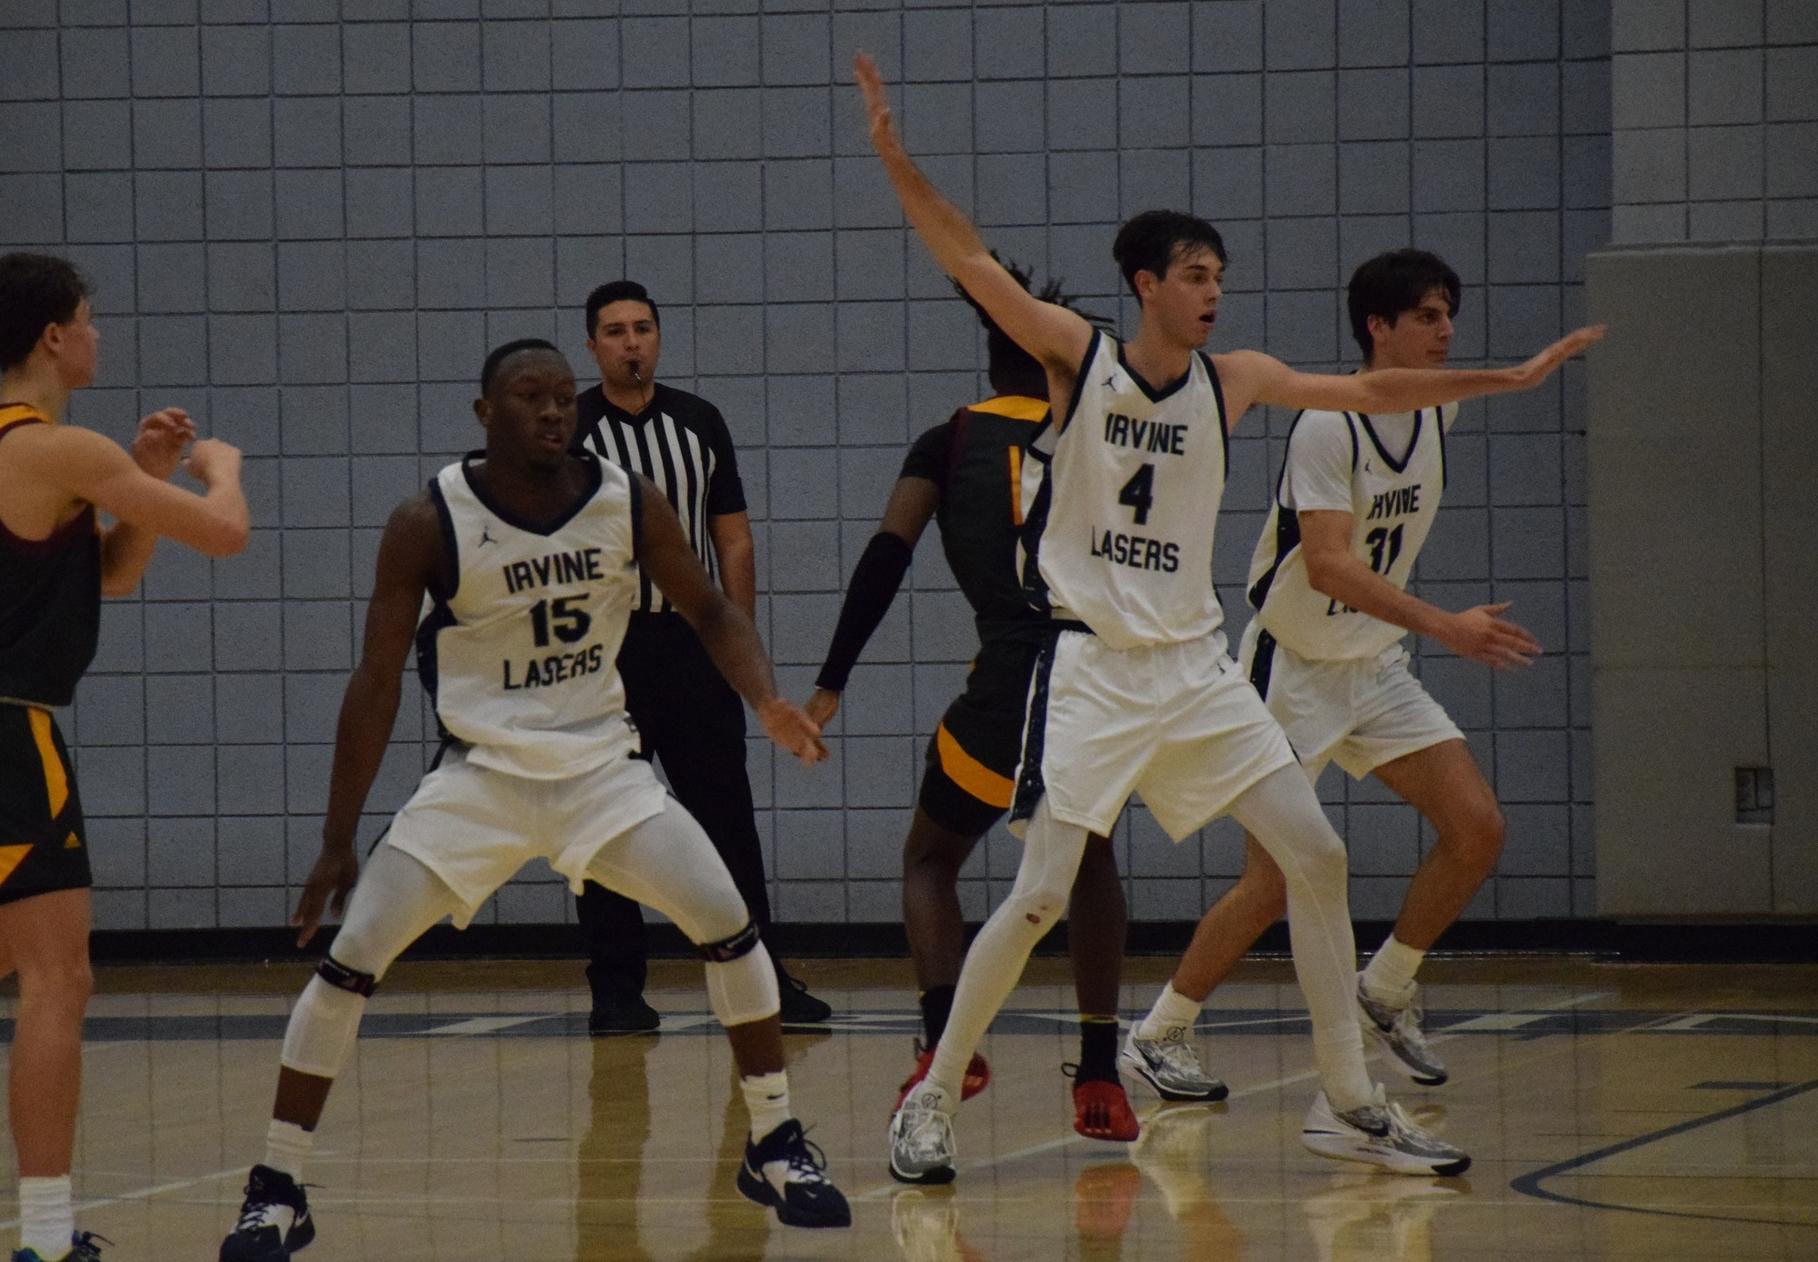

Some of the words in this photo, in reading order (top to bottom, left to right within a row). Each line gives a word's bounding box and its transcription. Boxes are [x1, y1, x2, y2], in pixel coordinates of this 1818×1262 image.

[1104, 412, 1189, 455] IRVINE
[1117, 462, 1156, 526] 4
[503, 547, 606, 594] IRVINE
[1090, 525, 1181, 573] LASERS
[529, 592, 592, 647] 15
[503, 643, 603, 691] LASERS
